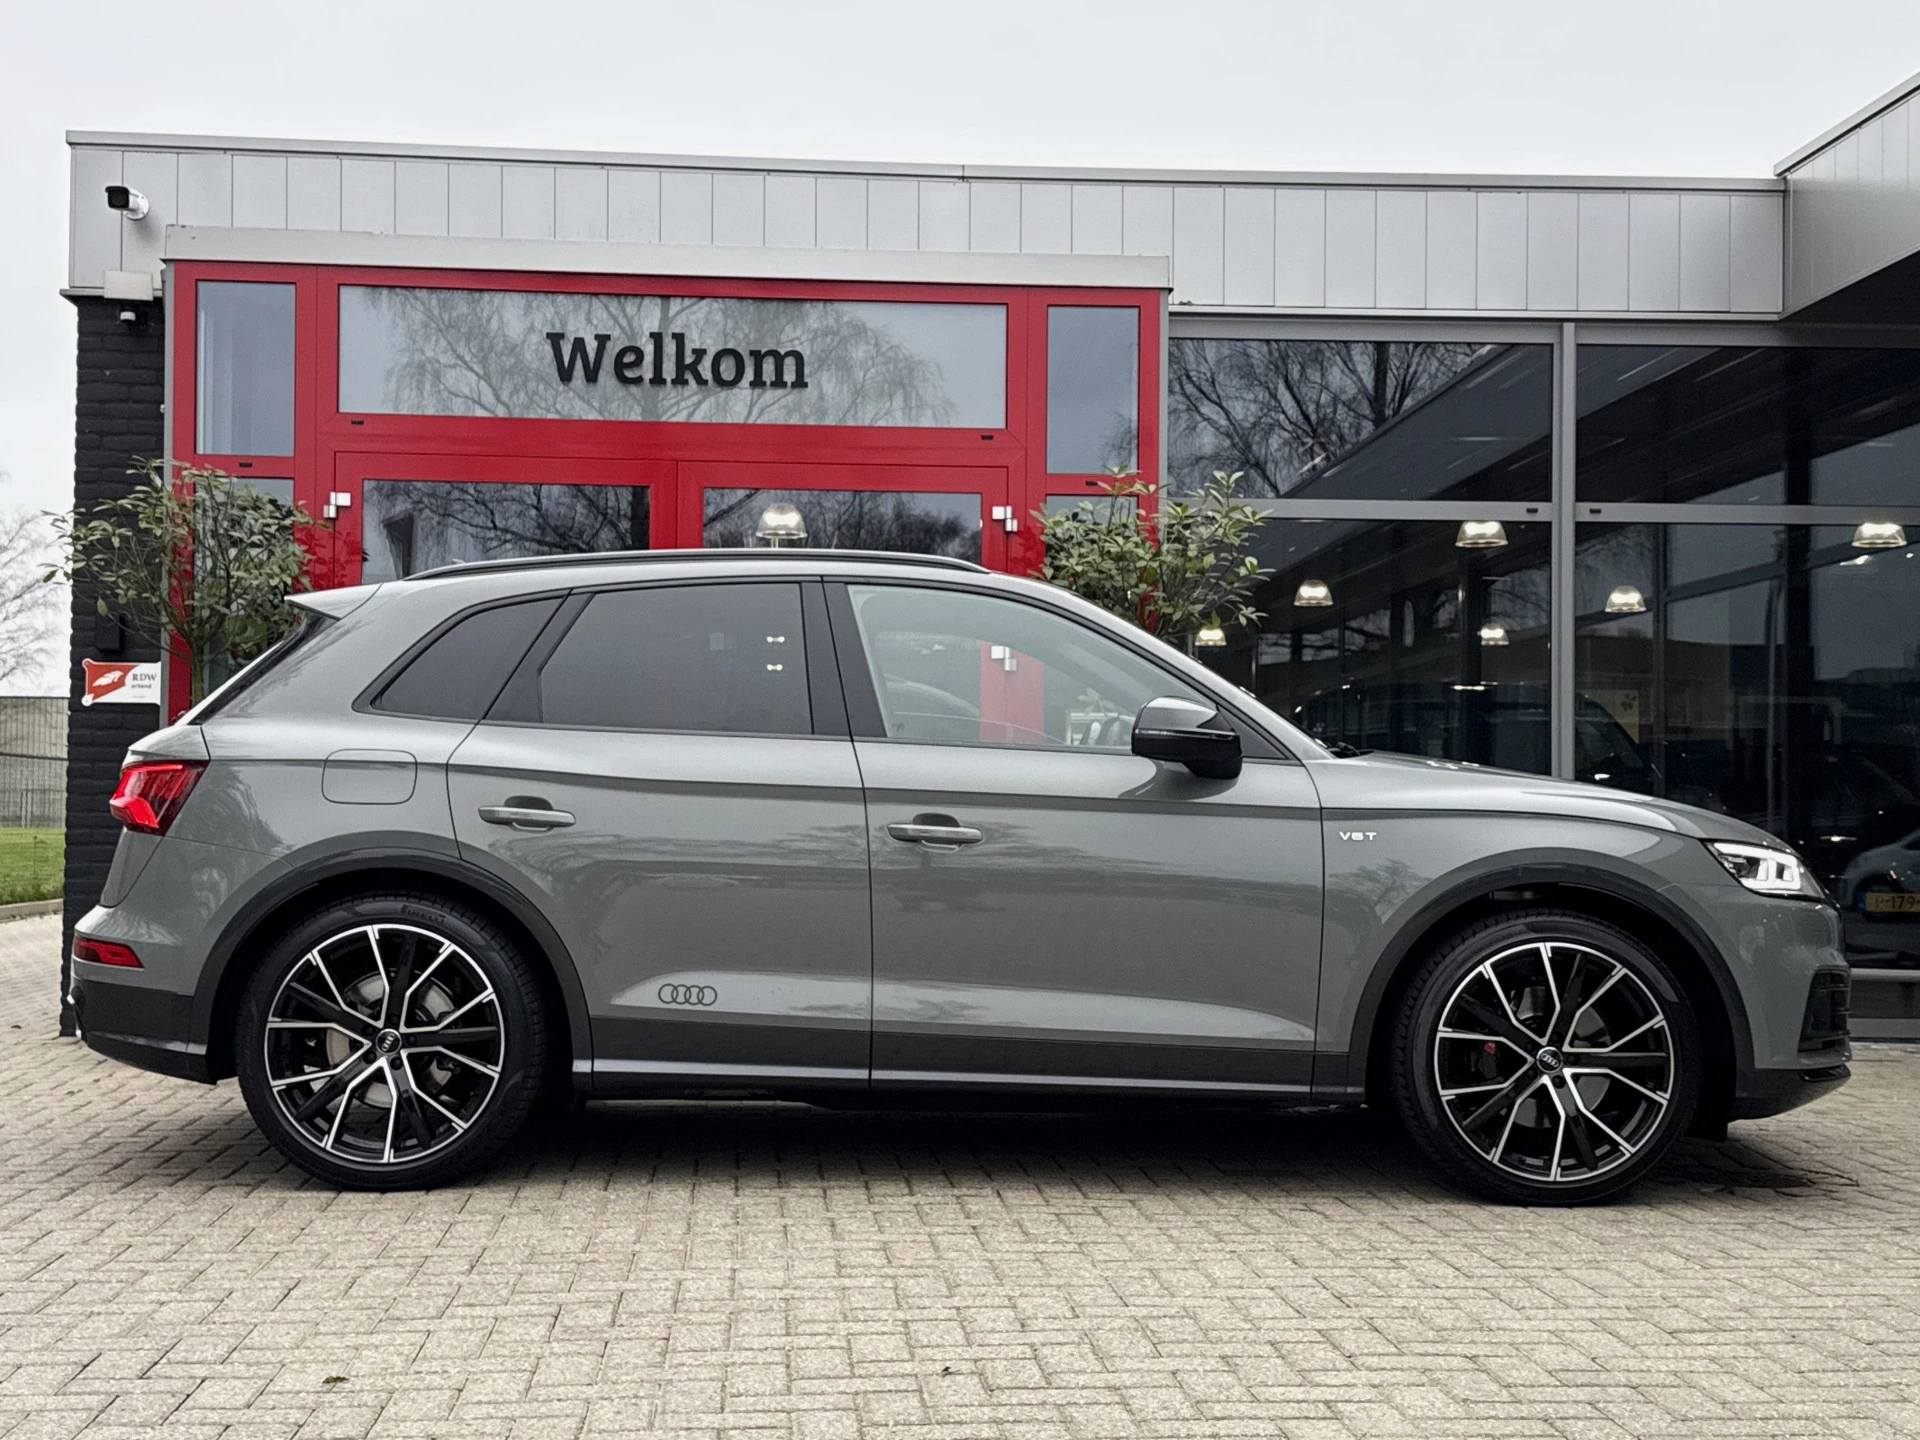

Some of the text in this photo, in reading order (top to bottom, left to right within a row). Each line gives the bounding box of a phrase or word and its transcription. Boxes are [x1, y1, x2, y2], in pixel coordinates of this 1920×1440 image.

[546, 331, 809, 389] Welkom
[132, 673, 157, 682] RDW
[1339, 831, 1377, 841] V6T
